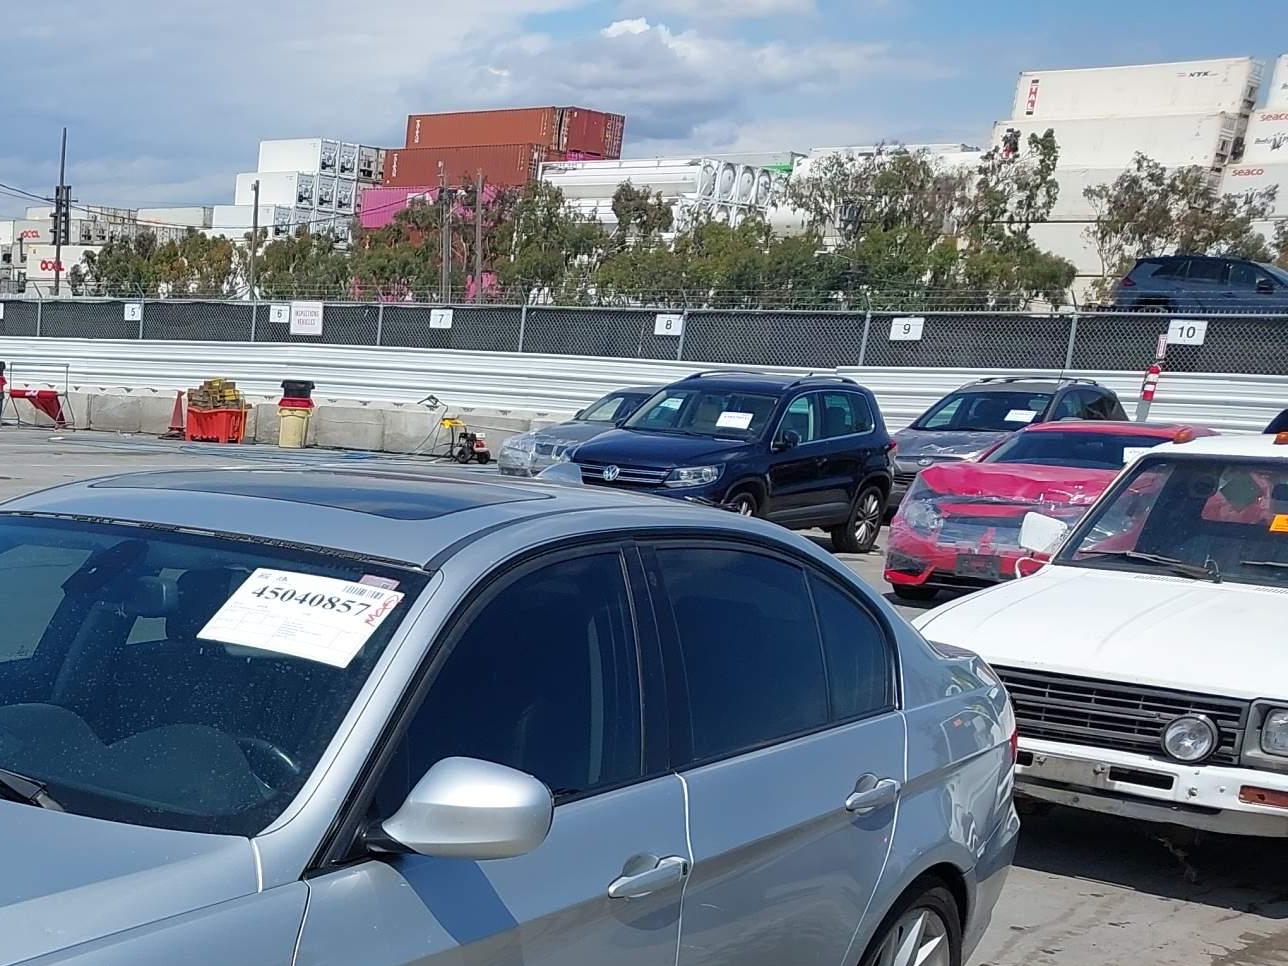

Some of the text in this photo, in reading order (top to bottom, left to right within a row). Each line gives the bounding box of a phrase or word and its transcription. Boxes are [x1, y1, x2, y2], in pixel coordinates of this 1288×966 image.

[1231, 168, 1264, 177] seaco
[131, 307, 136, 316] 5
[277, 309, 283, 318] 6
[438, 313, 445, 323] 7
[665, 320, 672, 330] 8
[903, 323, 911, 335] 9
[1178, 326, 1196, 339] 10
[252, 585, 372, 616] 45040857
